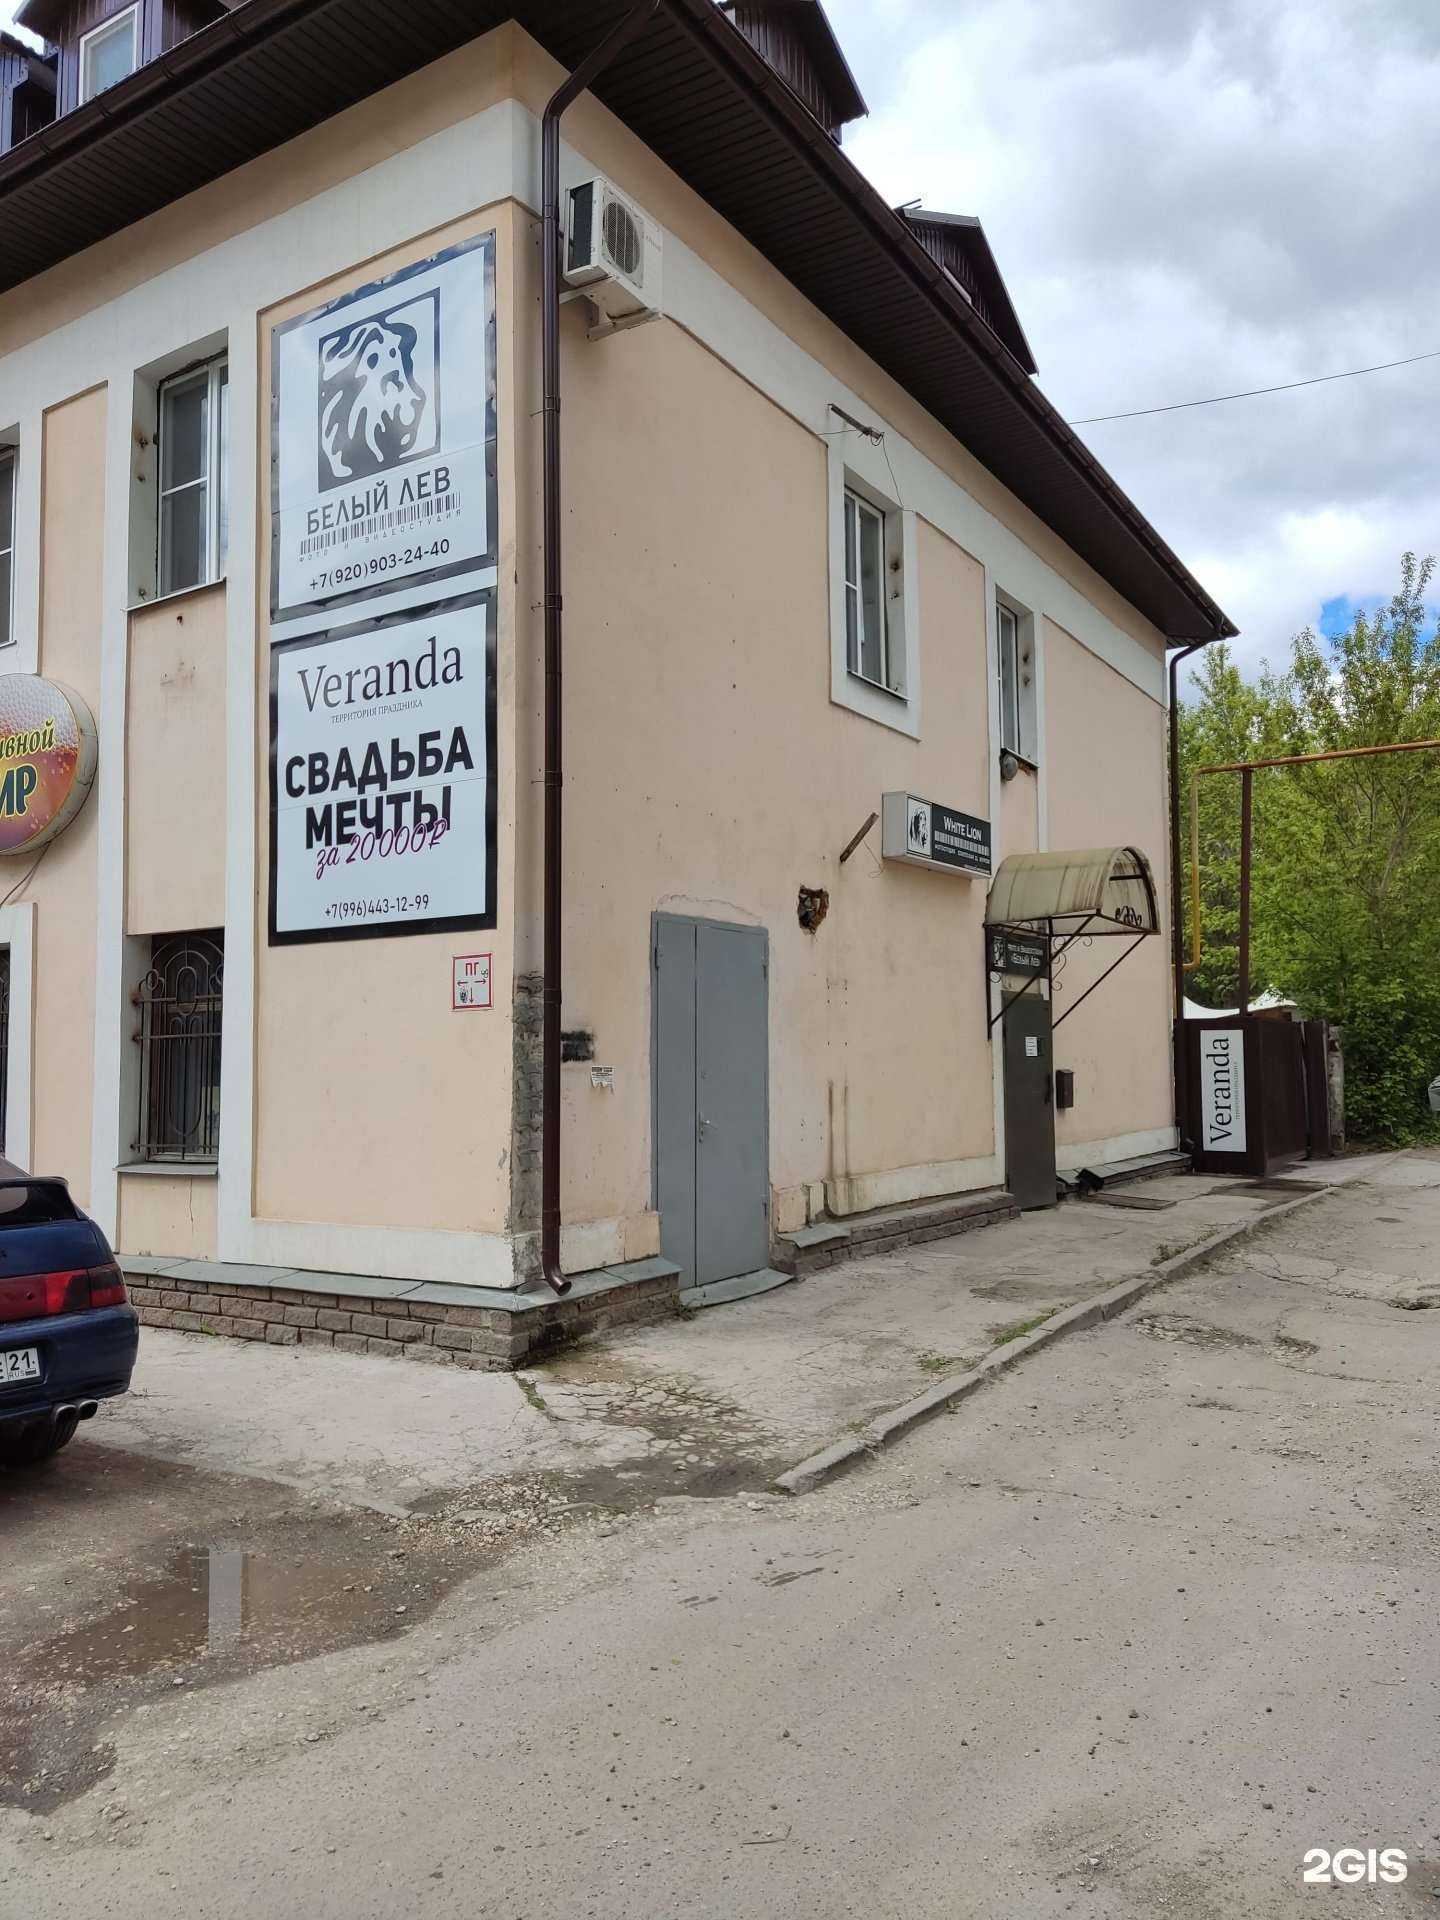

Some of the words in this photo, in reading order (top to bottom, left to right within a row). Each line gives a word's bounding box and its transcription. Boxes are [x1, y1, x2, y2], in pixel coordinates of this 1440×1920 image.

[306, 480, 389, 535] БЕЛЫЙ
[399, 466, 451, 505] ЛЕВ
[365, 509, 463, 543] ВИДЕОСТУДИЯ
[310, 538, 450, 590] +7(920)903-24-40
[297, 636, 464, 713] Veranda
[331, 706, 377, 725] ТЕРРИТОРИЯ
[378, 699, 423, 718] ПРАЗДНИКА
[285, 726, 474, 799] СВАДЬБА
[305, 785, 452, 850] МЕЧТЫ
[315, 845, 340, 880] за
[325, 894, 430, 920] +7(996)443-12-99
[465, 962, 479, 976] ПГ
[1206, 1037, 1233, 1144] Veranda
[9, 1351, 31, 1371] 21
